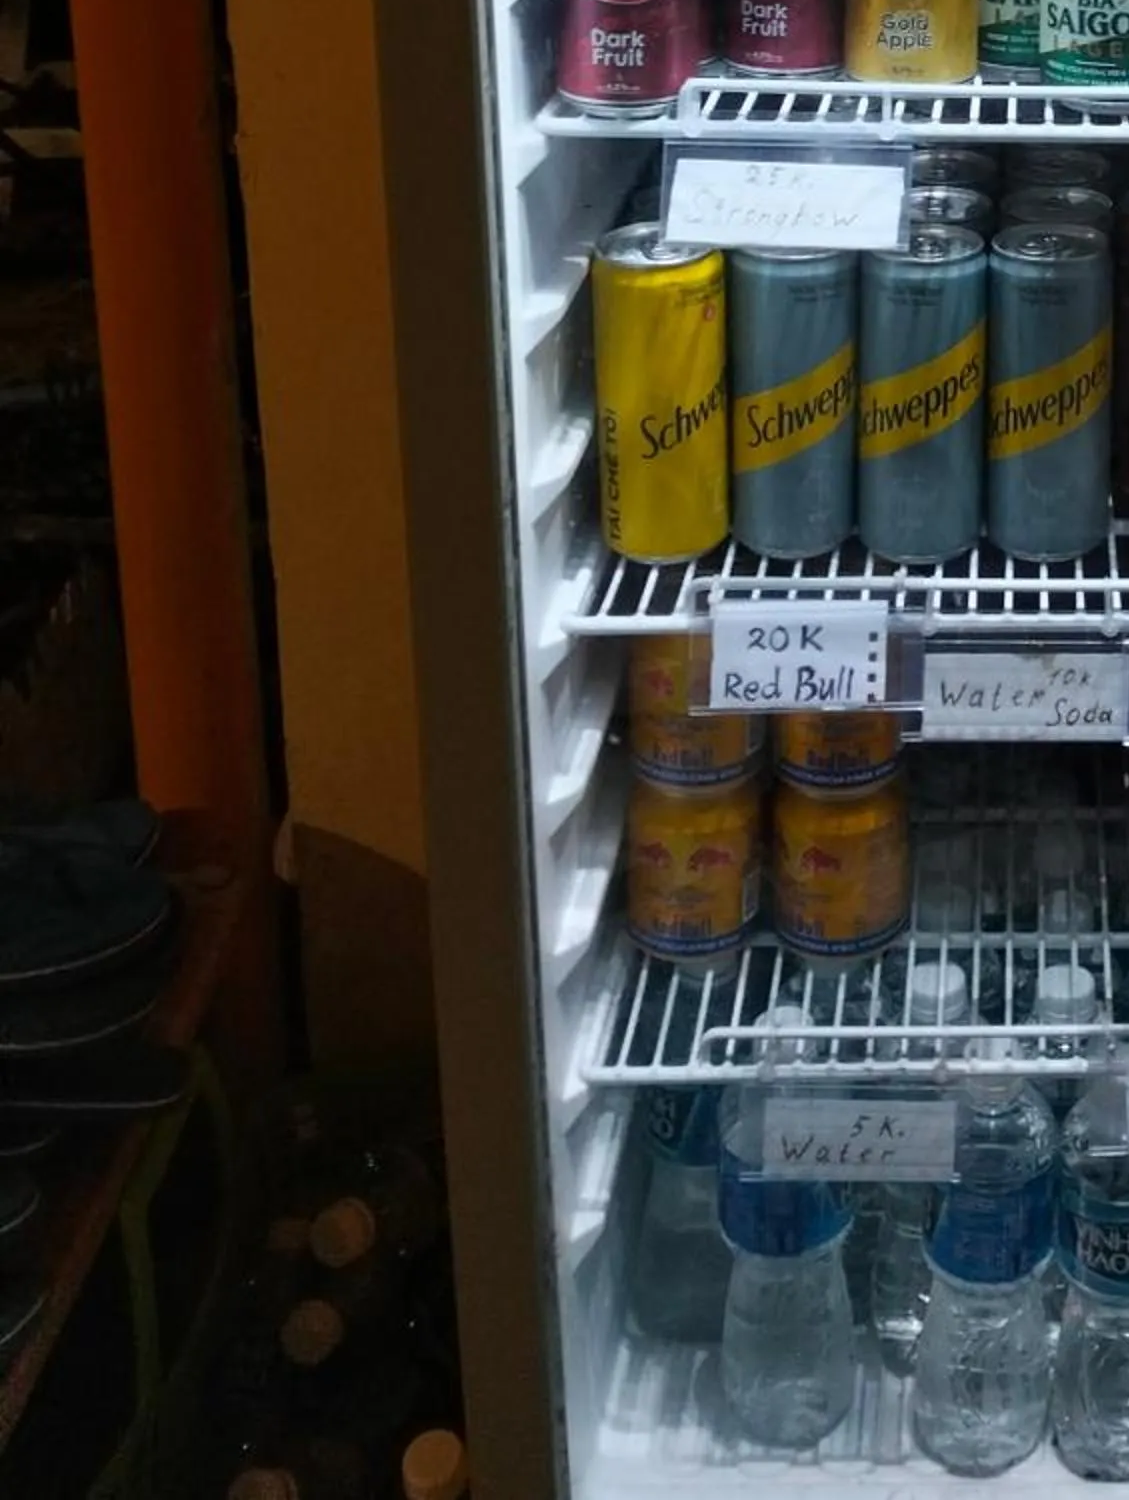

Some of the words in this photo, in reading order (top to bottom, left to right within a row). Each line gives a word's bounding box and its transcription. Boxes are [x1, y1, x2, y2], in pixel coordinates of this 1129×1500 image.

[741, 0, 788, 19] Dark
[882, 11, 929, 31] Gold
[591, 28, 646, 49] Dark
[741, 18, 788, 38] Fruit
[876, 30, 932, 52] Apple
[592, 48, 645, 67] Fruit
[862, 353, 980, 436] chweppes
[990, 358, 1109, 438] chweppes
[724, 667, 781, 702] Red
[794, 665, 855, 702] Bull
[940, 680, 1046, 709] Water
[1045, 699, 1112, 727] Soda
[781, 1133, 897, 1164] Water
